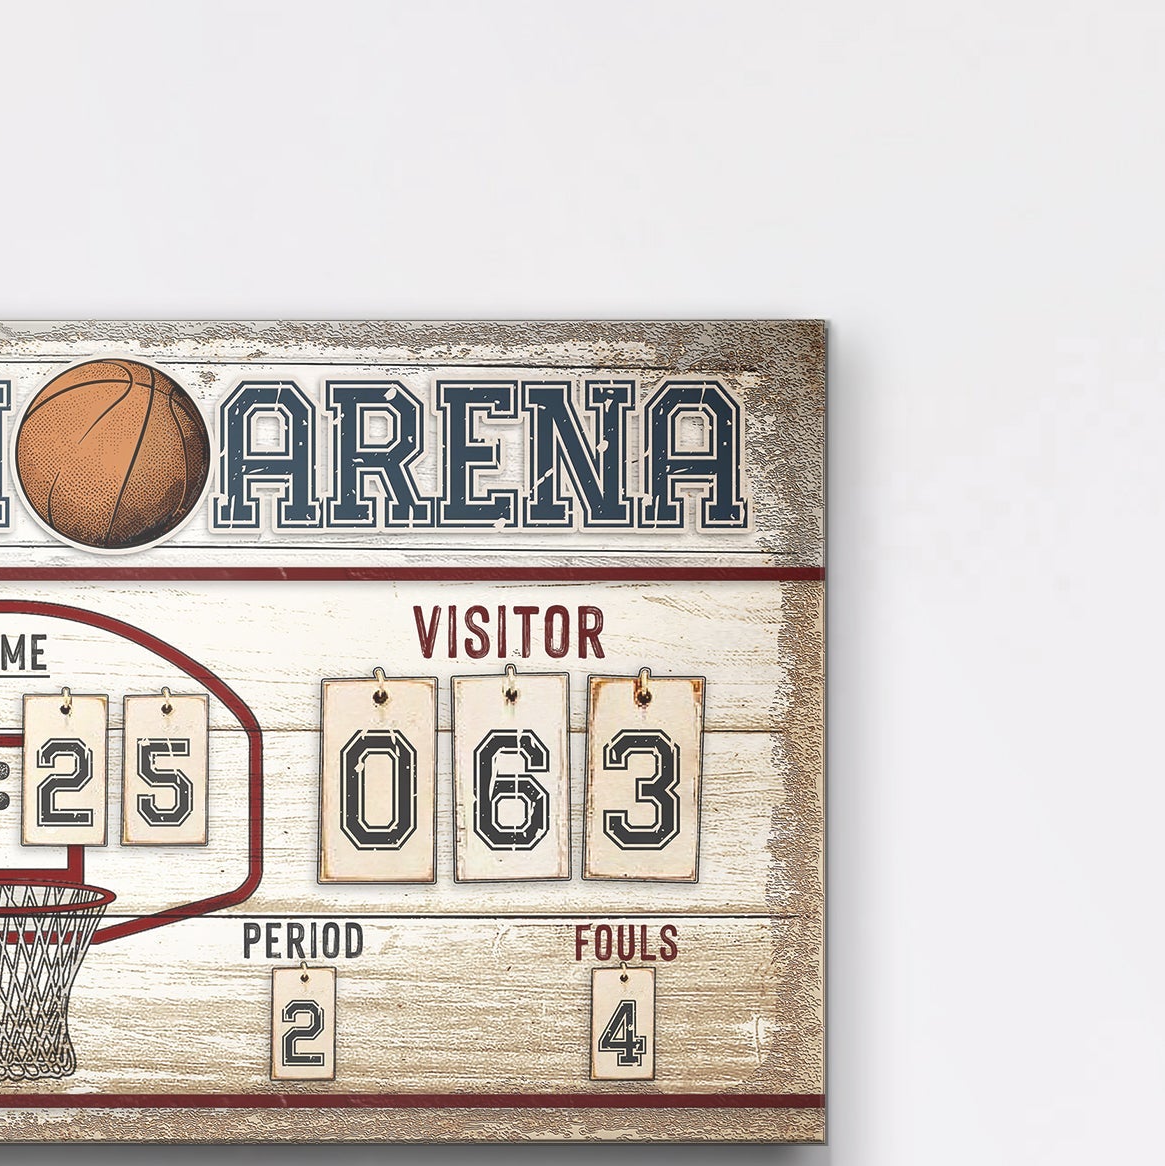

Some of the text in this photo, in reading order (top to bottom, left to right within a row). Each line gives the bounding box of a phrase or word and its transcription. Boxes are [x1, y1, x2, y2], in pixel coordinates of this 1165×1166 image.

[214, 379, 750, 528] ARENA
[413, 605, 604, 659] VISITOR
[243, 922, 364, 960] PERIOD
[575, 924, 679, 961] FOULS
[281, 1000, 324, 1066] 2
[598, 1000, 646, 1066] 4
